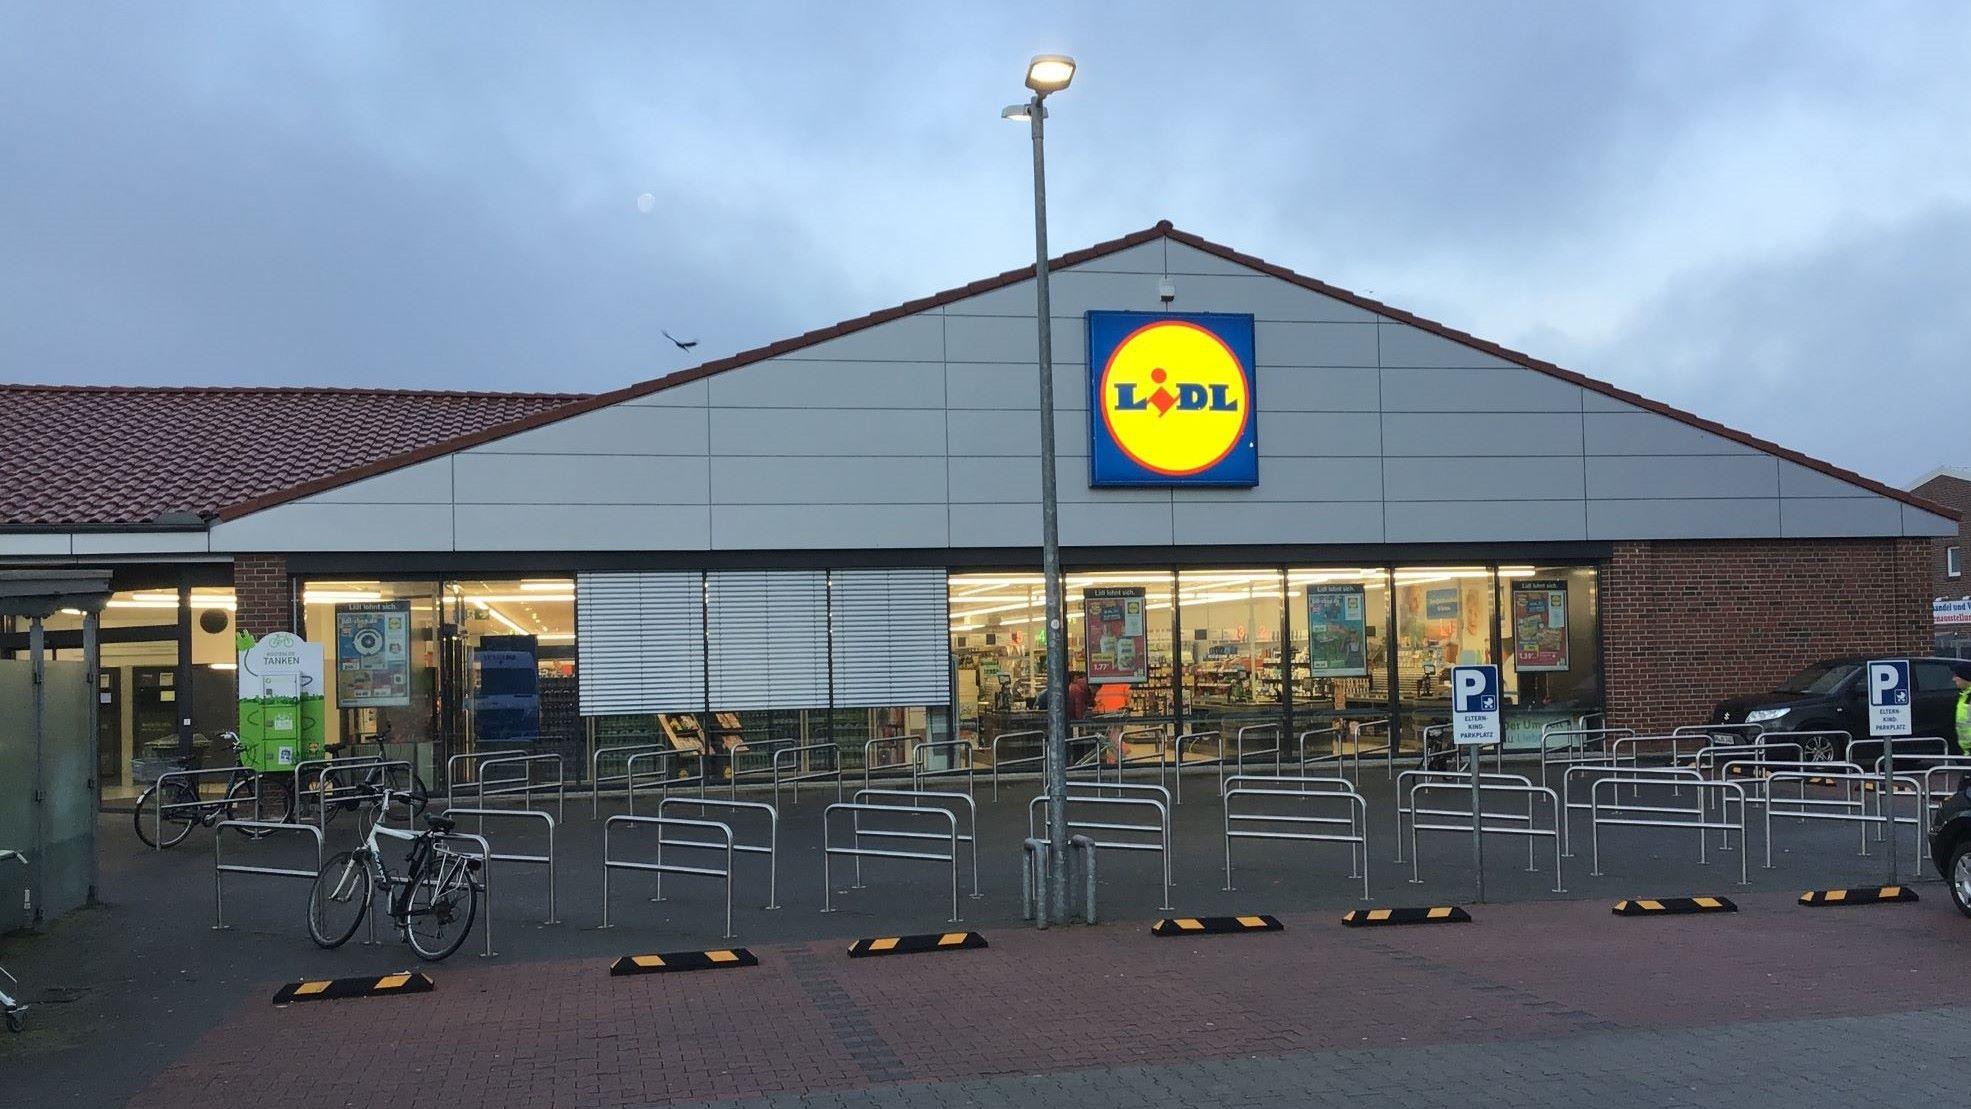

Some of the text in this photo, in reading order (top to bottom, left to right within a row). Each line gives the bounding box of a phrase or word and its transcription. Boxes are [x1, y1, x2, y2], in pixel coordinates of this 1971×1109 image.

[1953, 602, 1966, 611] und
[1455, 669, 1486, 711] P
[1871, 664, 1899, 705] P
